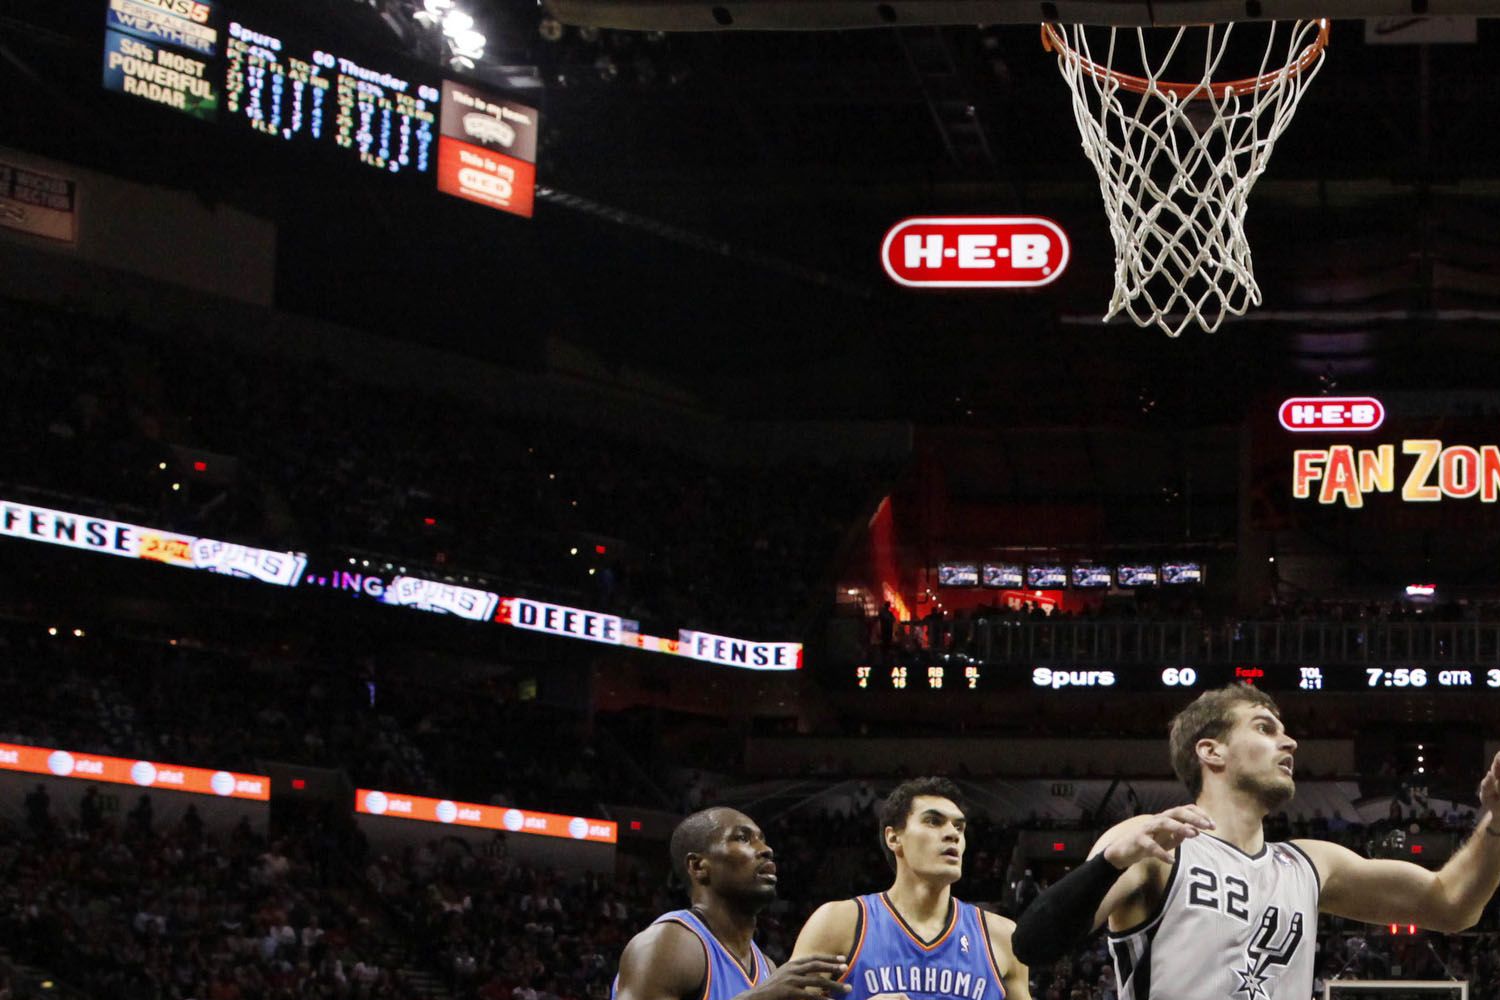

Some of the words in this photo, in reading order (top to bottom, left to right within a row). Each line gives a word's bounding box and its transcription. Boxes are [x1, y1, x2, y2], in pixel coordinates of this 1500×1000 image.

[229, 22, 281, 51] Spurs
[313, 51, 335, 69] 60
[109, 51, 215, 101] POWERFUL
[158, 50, 206, 77] MOST
[338, 58, 408, 92] Thunder
[124, 75, 186, 109] RADAR
[904, 234, 1051, 269] H-E-B
[1291, 405, 1374, 424] H-E-B
[1293, 445, 1394, 508] FAN
[4, 505, 132, 552] FENSE
[518, 601, 618, 642] DEEEE
[696, 634, 788, 666] FENSE
[856, 667, 871, 678] ST
[891, 667, 907, 678] AS
[928, 667, 944, 678] RB
[859, 678, 867, 688] 4
[969, 678, 977, 688] 2
[1033, 667, 1116, 689] Spurs
[1162, 667, 1196, 687] 60
[1300, 667, 1322, 679] TOL
[1366, 668, 1427, 687] 7:56
[1438, 670, 1472, 686] QTR
[1300, 679, 1322, 690] 4:1
[1189, 866, 1249, 922] 22
